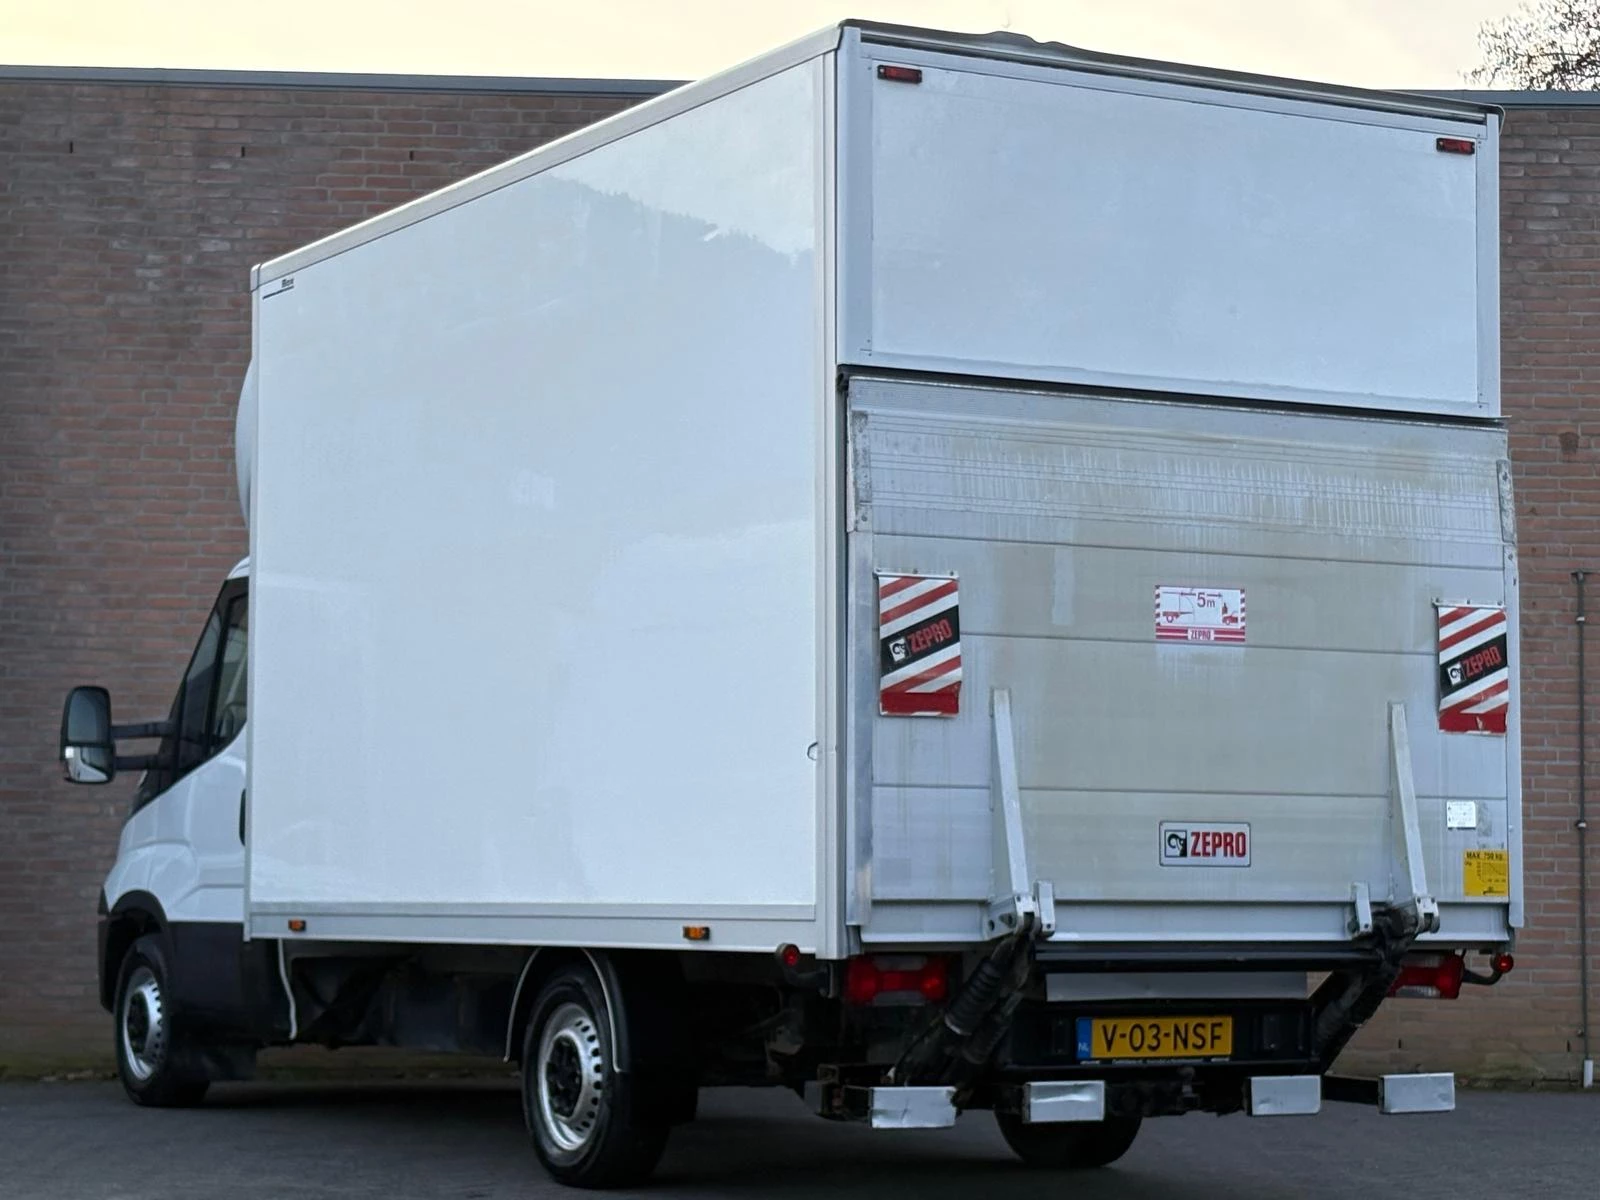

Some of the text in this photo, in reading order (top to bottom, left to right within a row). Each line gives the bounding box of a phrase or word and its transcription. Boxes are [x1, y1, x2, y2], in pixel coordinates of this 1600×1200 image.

[907, 619, 953, 653] ZEPRO
[1190, 629, 1211, 640] ZEPRO
[1463, 646, 1502, 678] ZEPRO
[1190, 831, 1246, 858] ZEPRO
[1078, 1042, 1089, 1052] NL
[1102, 1022, 1223, 1052] V-03-NSF
